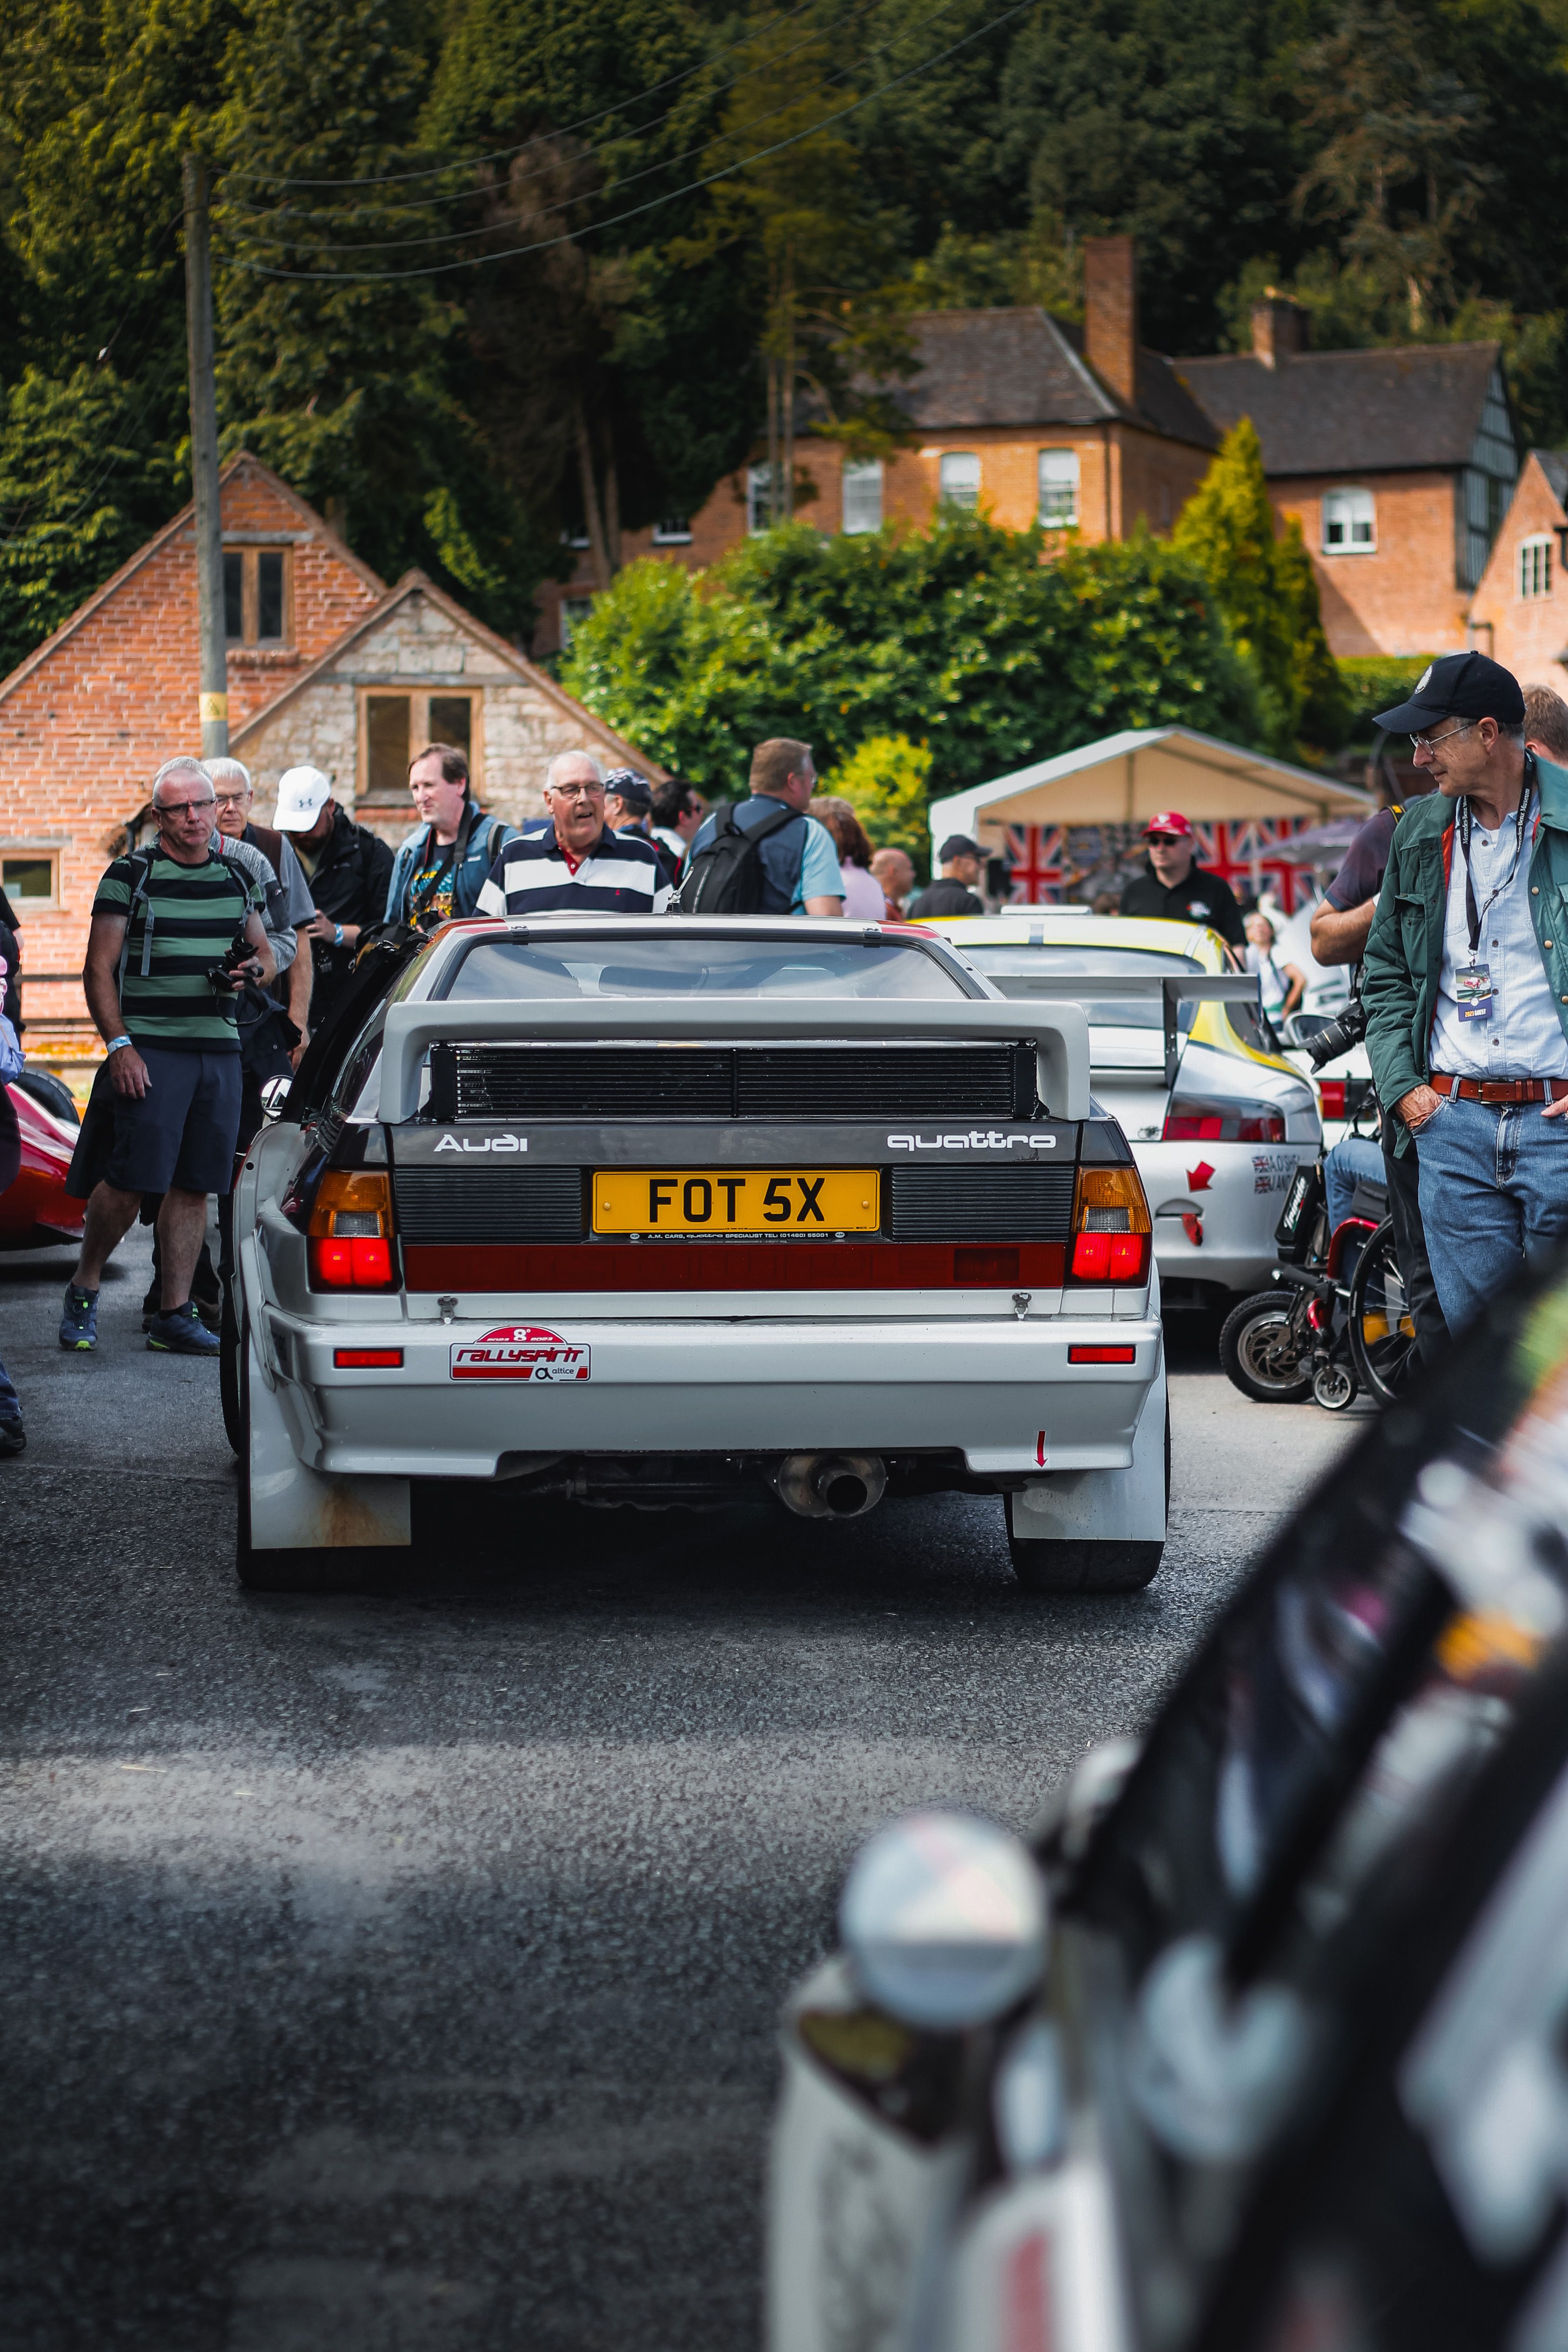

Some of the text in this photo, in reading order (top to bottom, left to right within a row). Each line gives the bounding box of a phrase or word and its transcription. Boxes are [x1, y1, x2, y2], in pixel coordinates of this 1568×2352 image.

[1521, 788, 1530, 812] Museum
[433, 1134, 528, 1152] Audi
[887, 1131, 1056, 1152] quattro
[650, 1178, 825, 1223] FOT 5X
